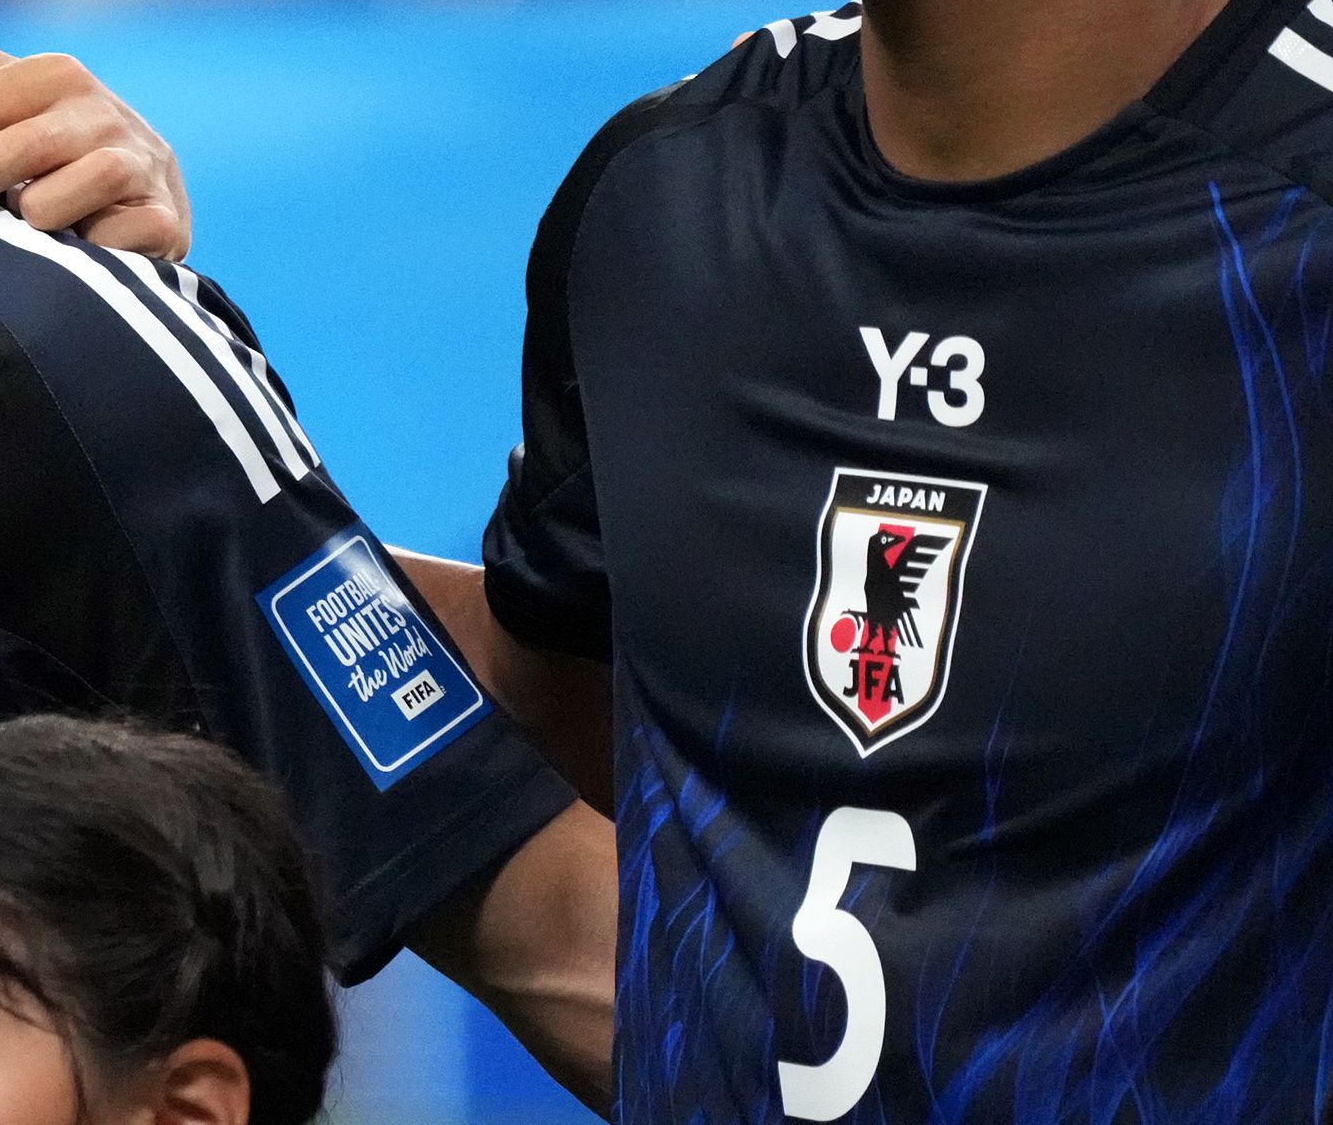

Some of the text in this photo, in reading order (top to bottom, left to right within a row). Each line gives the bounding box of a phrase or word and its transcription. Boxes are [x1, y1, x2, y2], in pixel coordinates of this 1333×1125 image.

[859, 327, 986, 428] Y-3
[866, 483, 945, 512] JAPAN
[306, 572, 381, 633] FOOTBALL
[324, 594, 407, 667] UNITES
[348, 625, 433, 702] the World
[402, 680, 436, 710] FIFA
[843, 660, 905, 707] JFA
[778, 807, 917, 1122] 5
